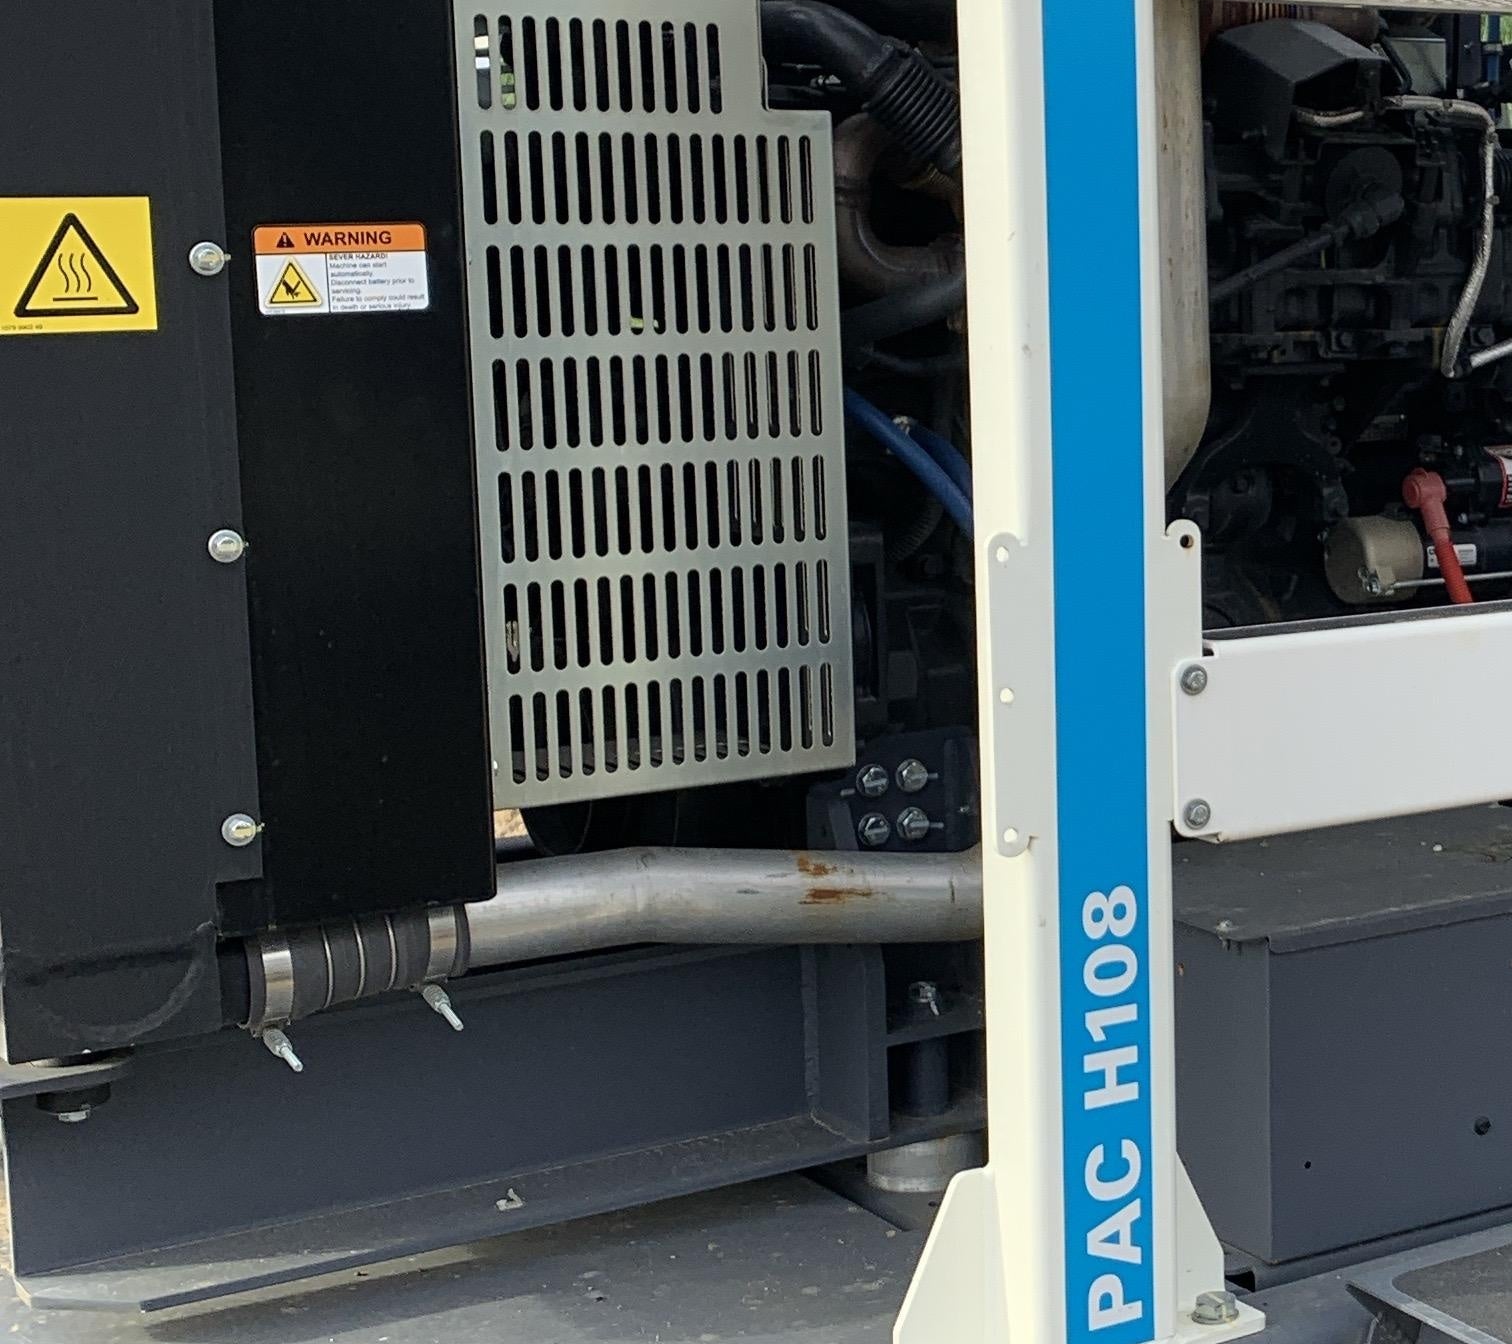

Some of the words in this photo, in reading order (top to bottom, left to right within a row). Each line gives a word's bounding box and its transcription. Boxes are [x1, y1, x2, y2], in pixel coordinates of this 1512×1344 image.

[304, 230, 392, 246] WARNING
[1081, 884, 1139, 1111] H108
[1085, 1138, 1144, 1332] PAC
